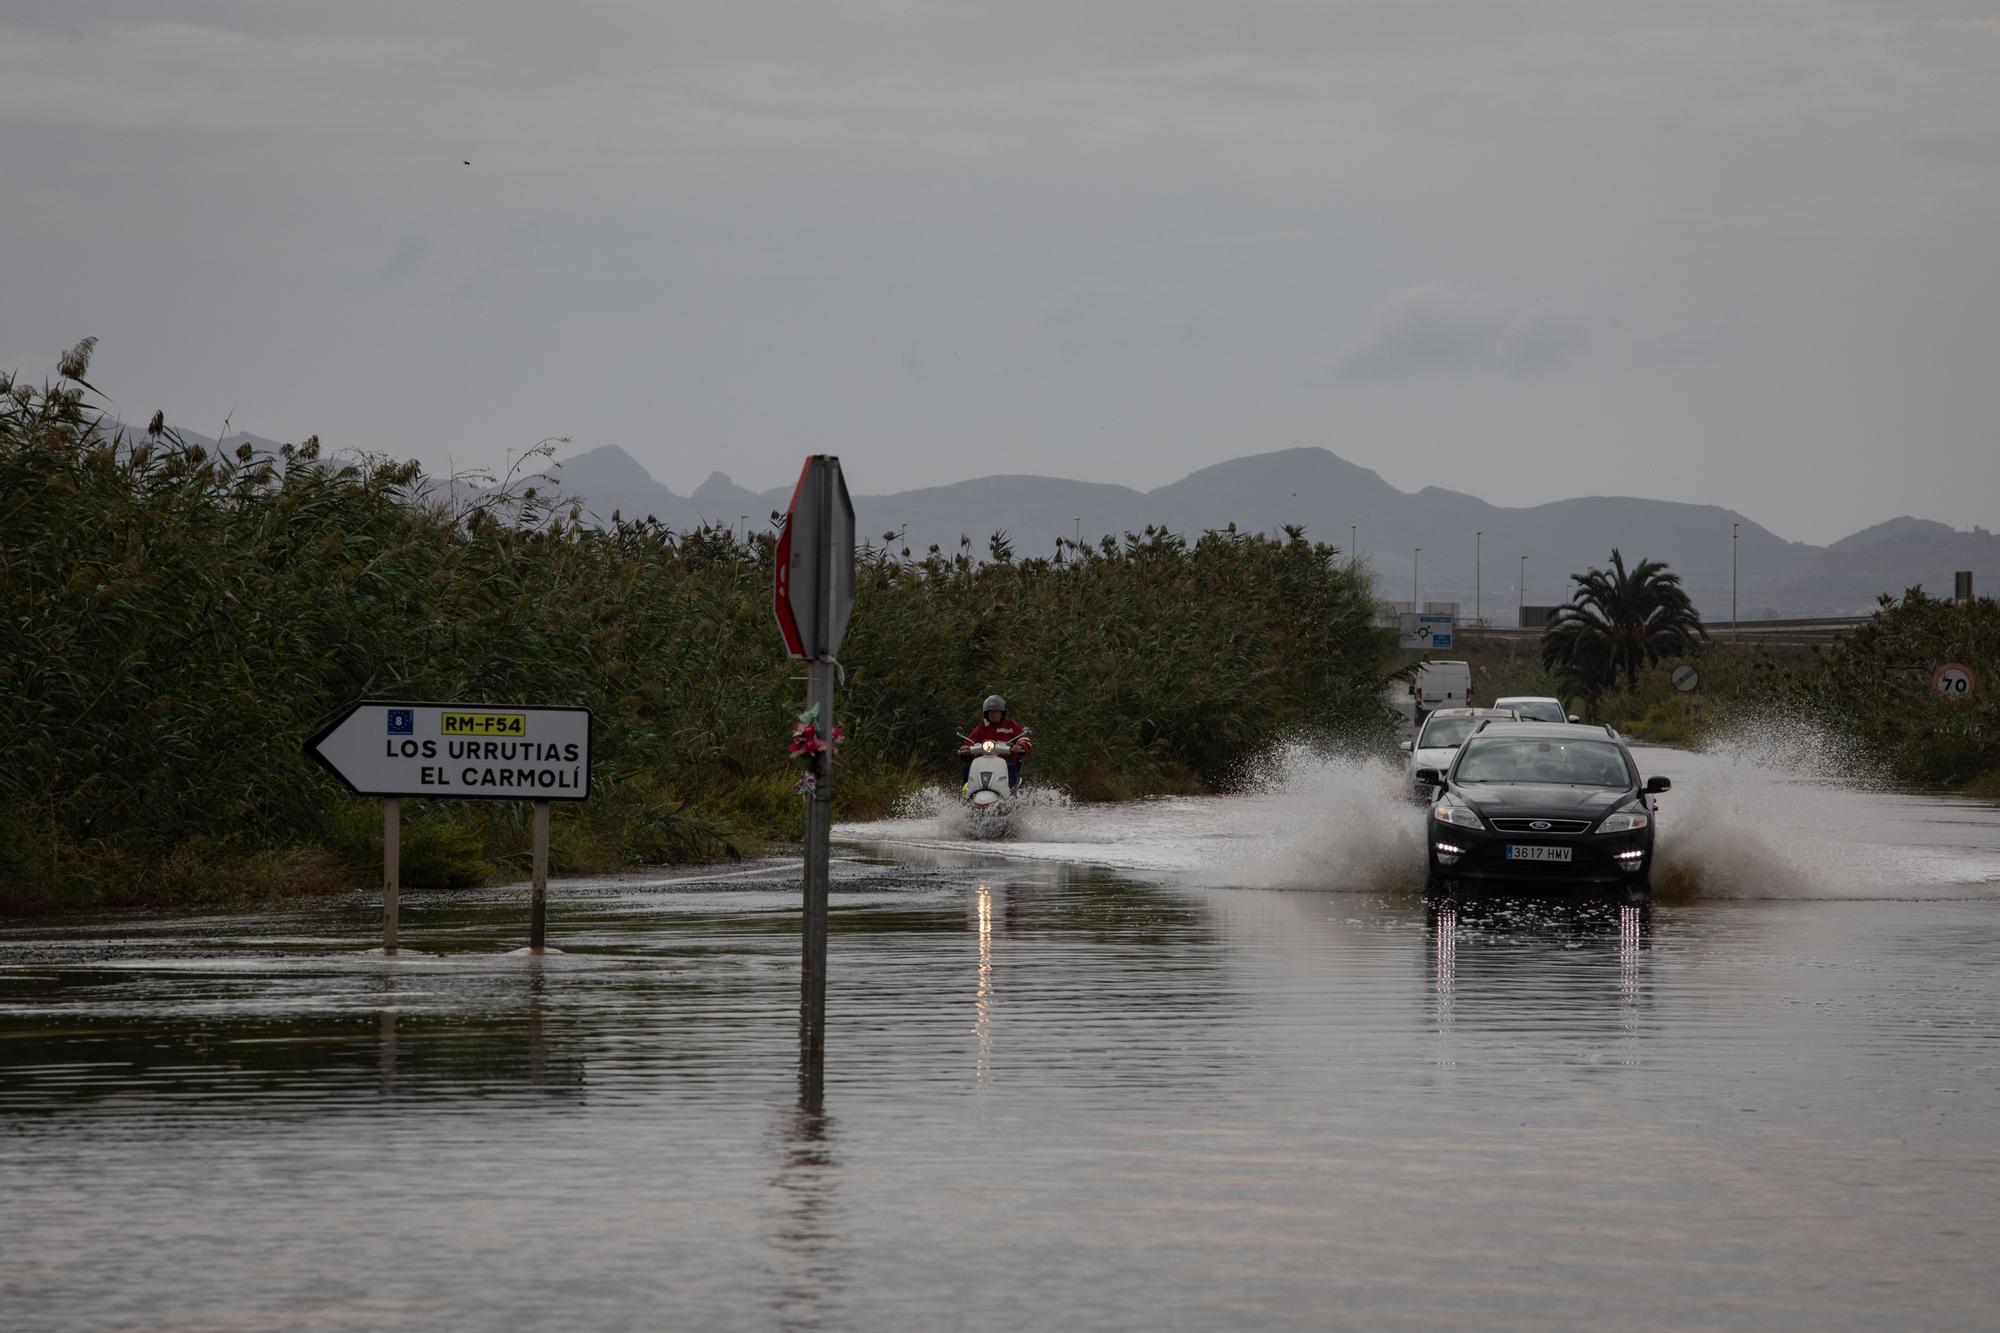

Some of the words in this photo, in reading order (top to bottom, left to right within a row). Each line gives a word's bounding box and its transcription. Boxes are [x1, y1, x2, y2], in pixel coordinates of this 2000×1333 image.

[1942, 678, 1967, 692] 70
[395, 716, 402, 726] 8
[445, 717, 521, 733] RM-F54
[386, 739, 437, 758] LOS
[448, 741, 580, 762] URRUTIAS
[420, 766, 450, 785] EL
[461, 766, 581, 789] CARMOLÍ
[1514, 847, 1543, 859] 3617
[1547, 848, 1570, 860] HMV
